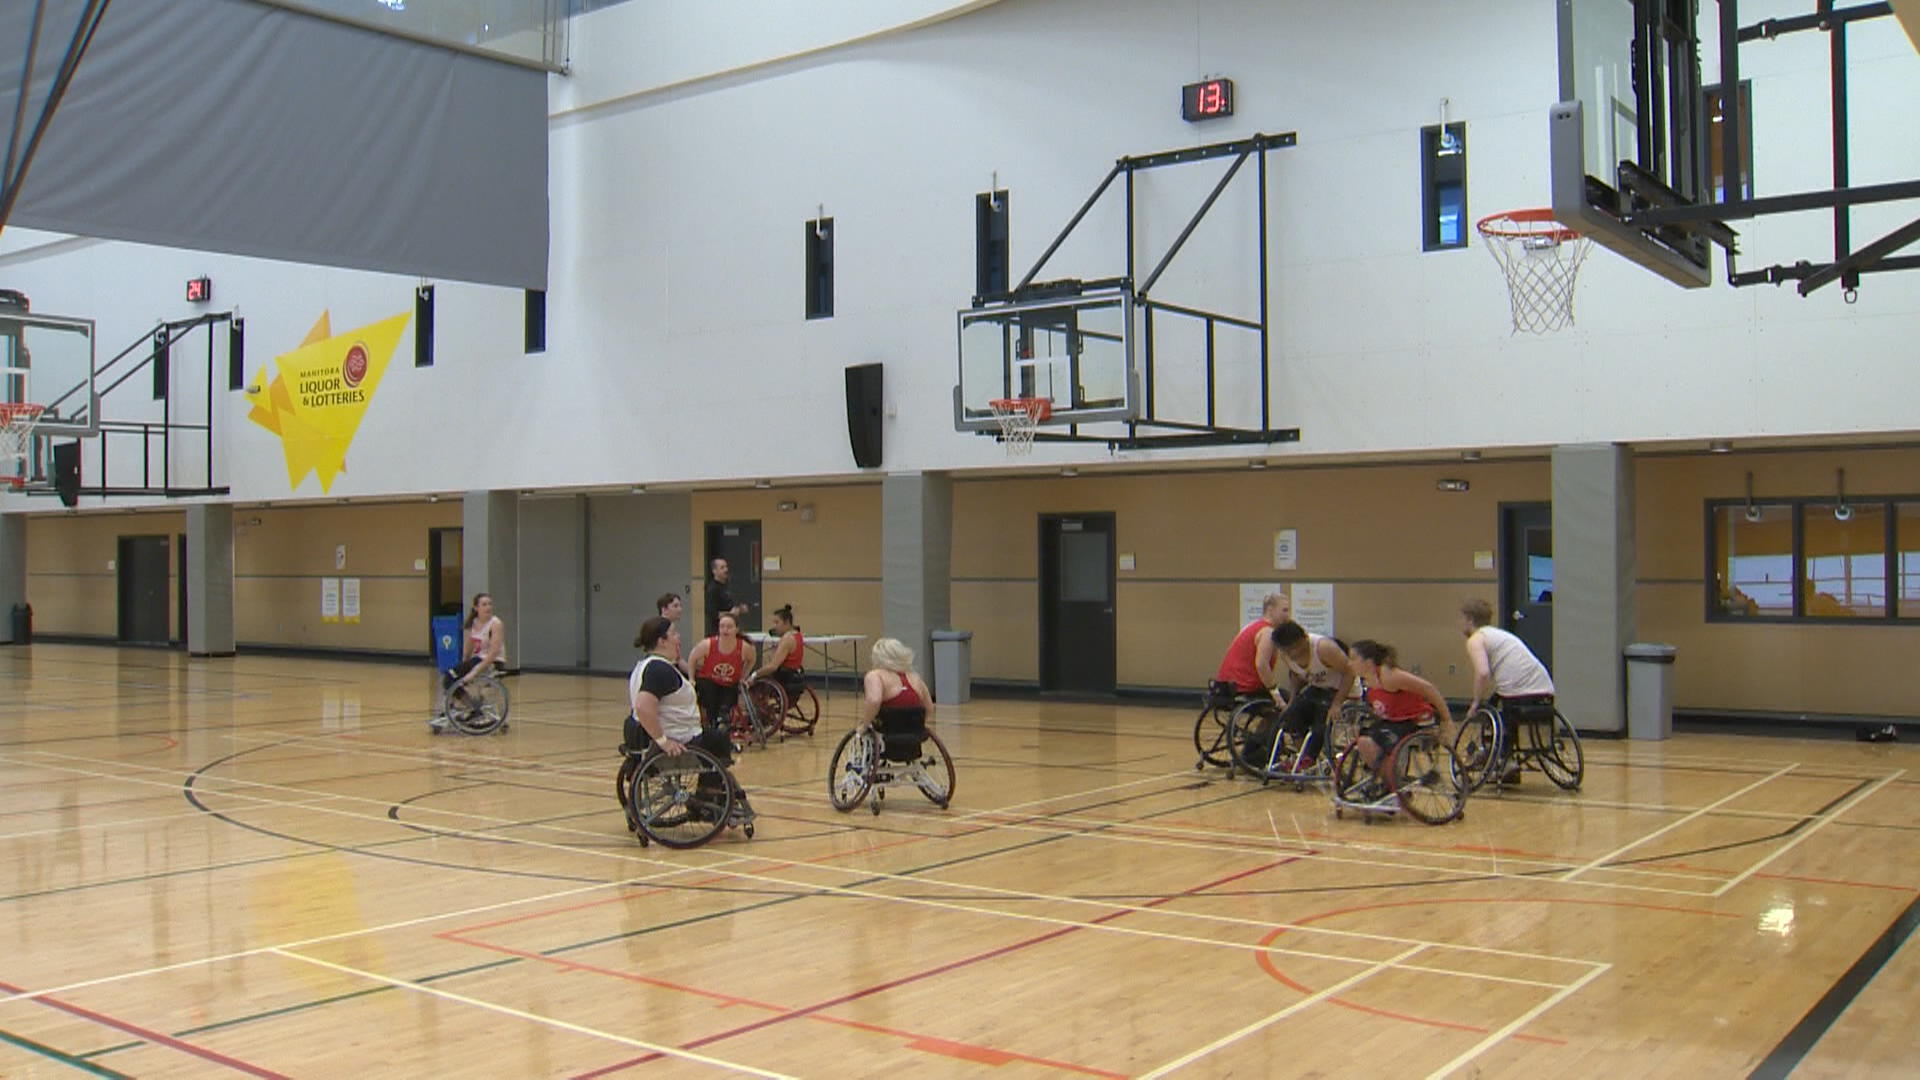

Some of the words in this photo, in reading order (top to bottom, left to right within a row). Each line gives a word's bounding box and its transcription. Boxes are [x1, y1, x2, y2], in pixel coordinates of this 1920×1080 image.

[300, 367, 340, 378] MANITOBA
[300, 378, 341, 395] LIQUOR
[303, 396, 310, 407] &
[311, 390, 365, 408] LOTTERIES
